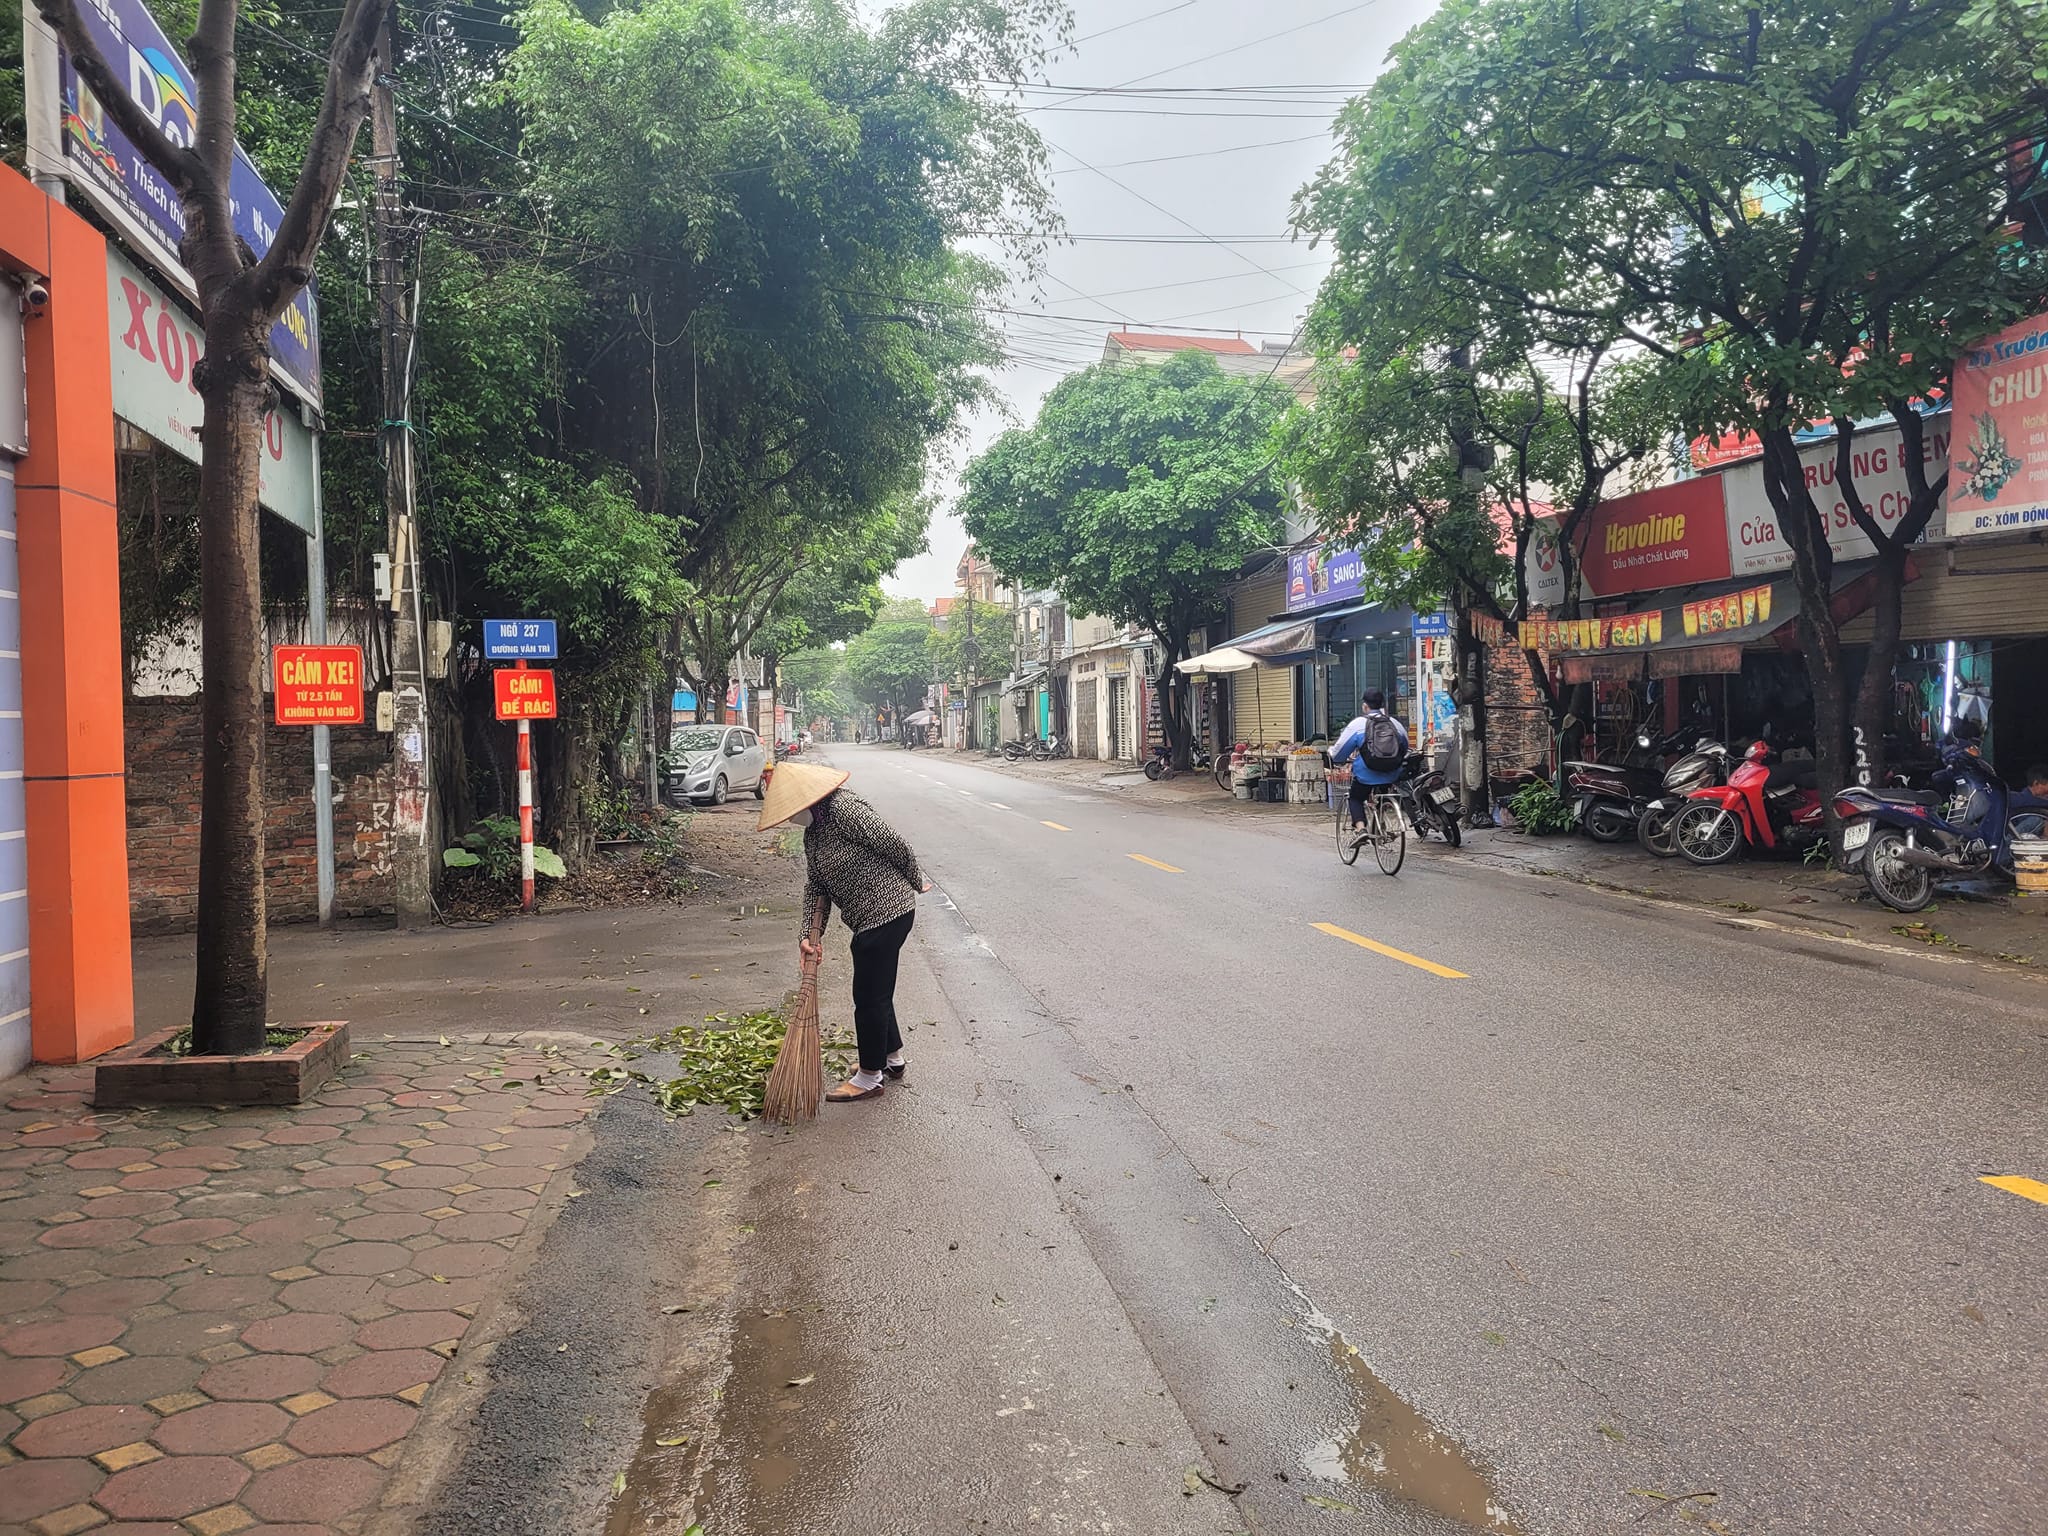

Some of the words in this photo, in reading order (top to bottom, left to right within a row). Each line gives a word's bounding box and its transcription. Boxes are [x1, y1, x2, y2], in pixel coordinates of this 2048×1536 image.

[132, 156, 167, 212] Thách
[1975, 515, 1992, 528] ĐC:
[1995, 510, 2020, 526] XÓM
[1605, 512, 1686, 555] Havoline
[1740, 515, 1776, 546] Cửa
[1627, 554, 1645, 567] Nhớt
[1645, 550, 1664, 564] Chất
[1664, 548, 1689, 561] Lượng
[1333, 562, 1355, 585] SANG
[1537, 577, 1559, 589] CALTEX
[500, 621, 518, 638] NGÕ
[523, 624, 540, 638] 237
[282, 653, 322, 686] CẤM
[326, 661, 354, 685] XE!
[509, 673, 543, 694] CẤM!
[309, 691, 323, 702] 2.5
[325, 688, 343, 701] TẤN
[284, 705, 315, 718] KHÔNG
[316, 705, 335, 717] VÀO
[523, 698, 550, 714] RÁC
